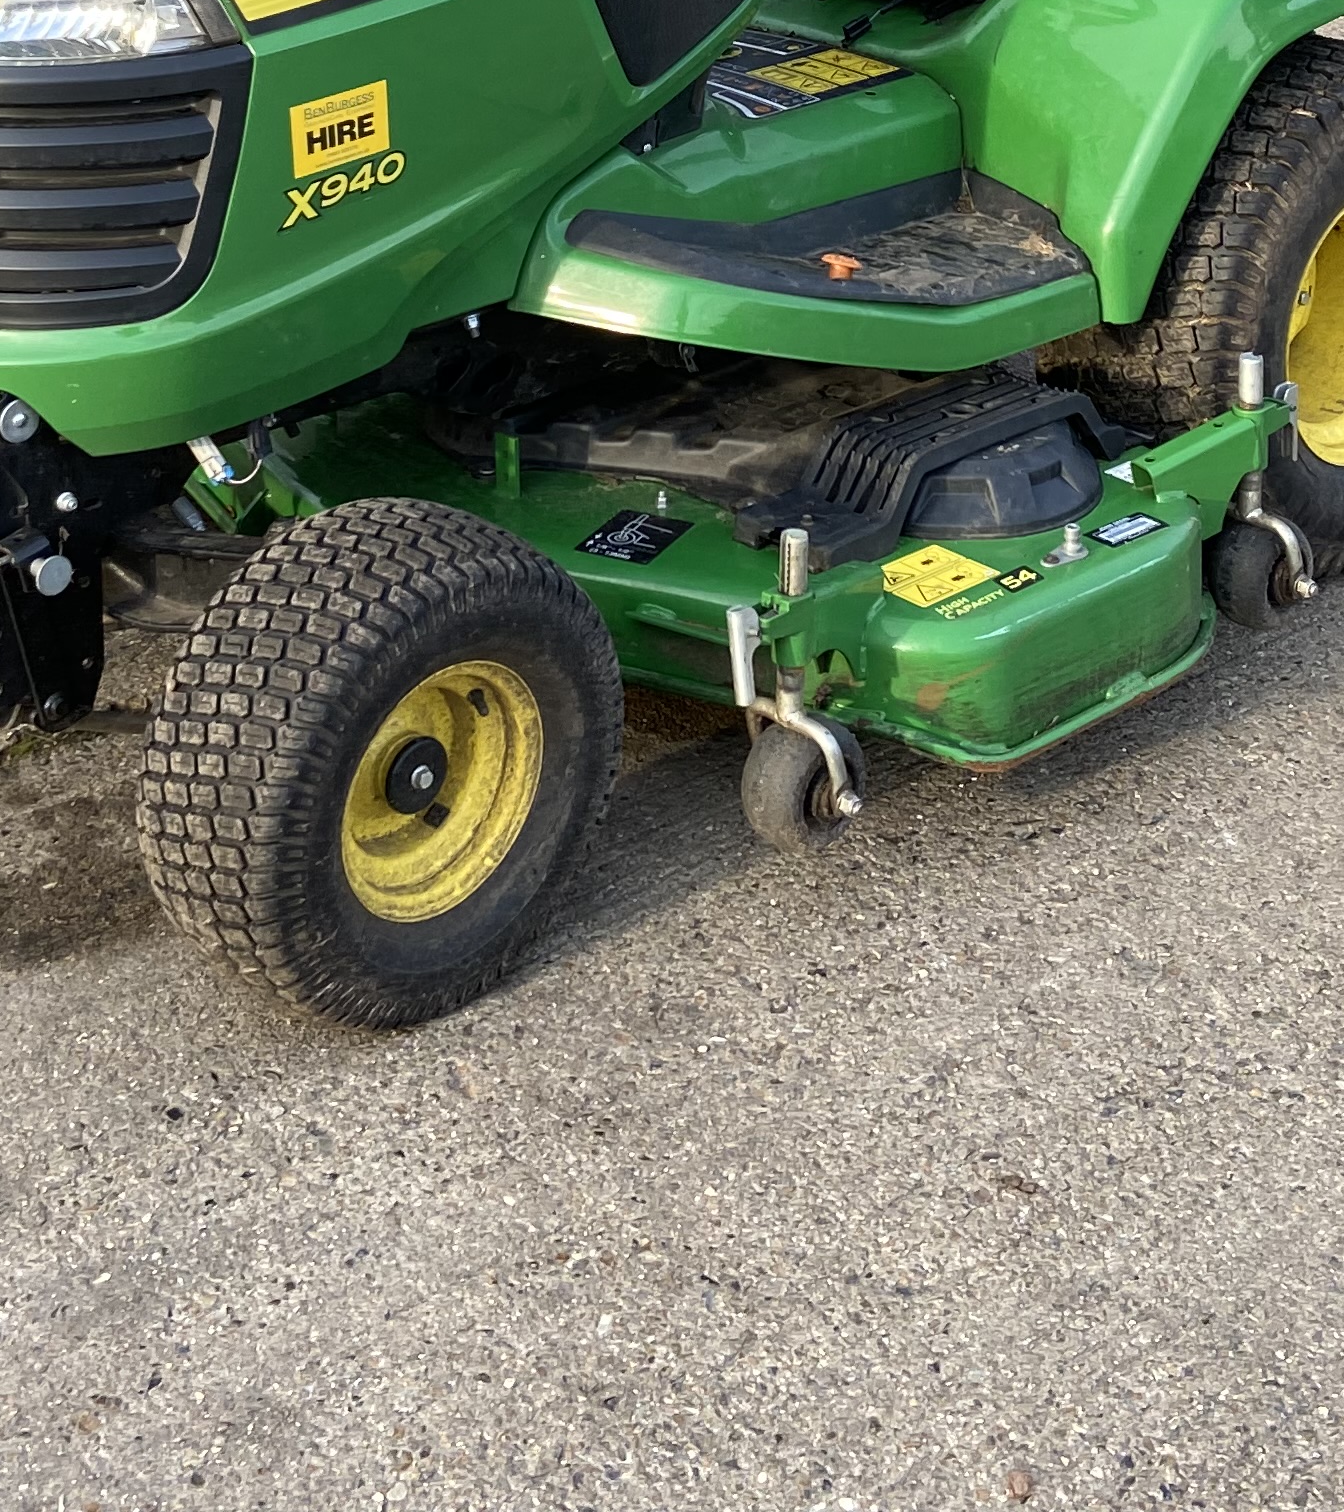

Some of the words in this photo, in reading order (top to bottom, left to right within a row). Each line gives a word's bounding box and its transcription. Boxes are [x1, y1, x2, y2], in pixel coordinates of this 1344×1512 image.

[306, 112, 376, 156] HIRE
[280, 151, 406, 230] X940
[999, 569, 1038, 590] 54
[935, 596, 970, 616] HIGH
[944, 589, 1005, 621] CAPACITY
